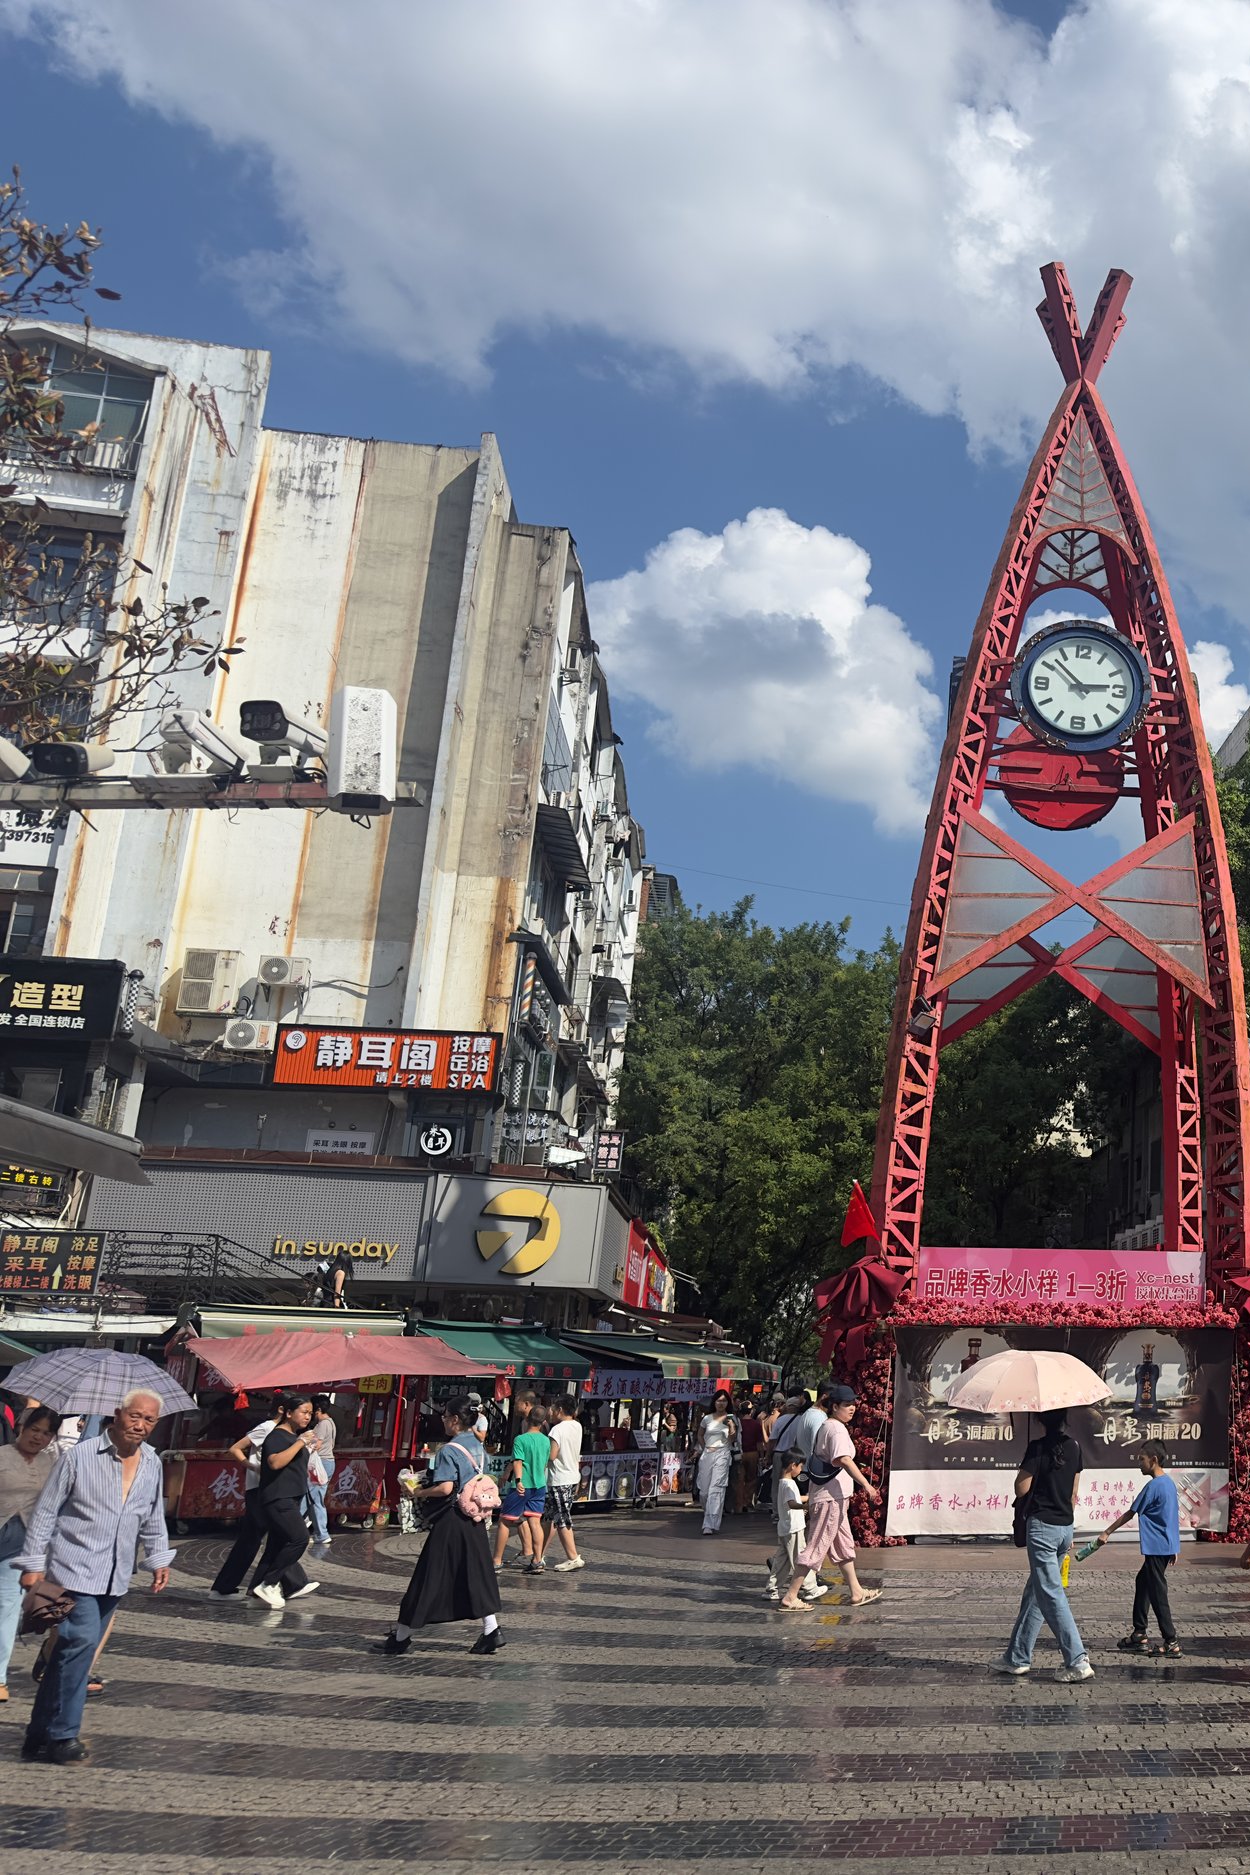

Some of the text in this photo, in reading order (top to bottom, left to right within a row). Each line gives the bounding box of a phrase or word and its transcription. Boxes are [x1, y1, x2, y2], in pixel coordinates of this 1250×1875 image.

[1075, 644, 1092, 660] 12
[10, 981, 85, 1011] 造型
[14, 1013, 86, 1029] 全国连锁店
[315, 1035, 493, 1071] 静耳阁 按摩
[449, 1054, 490, 1072] 足浴
[375, 1071, 433, 1086] 请上2楼
[448, 1073, 487, 1089] SPA
[0, 1171, 53, 1186] 二楼右转
[3, 1235, 99, 1254] 静耳阁 浴足
[4, 1255, 96, 1273] 采耳 按摩
[63, 1274, 92, 1290] 洗眼
[924, 1268, 1059, 1300] 品牌香水小样
[361, 1377, 388, 1391] 牛肉
[966, 1425, 1013, 1441] 洞藏10
[1146, 1421, 1202, 1441] 洞藏20
[1090, 1481, 1136, 1492] 夏日特惠
